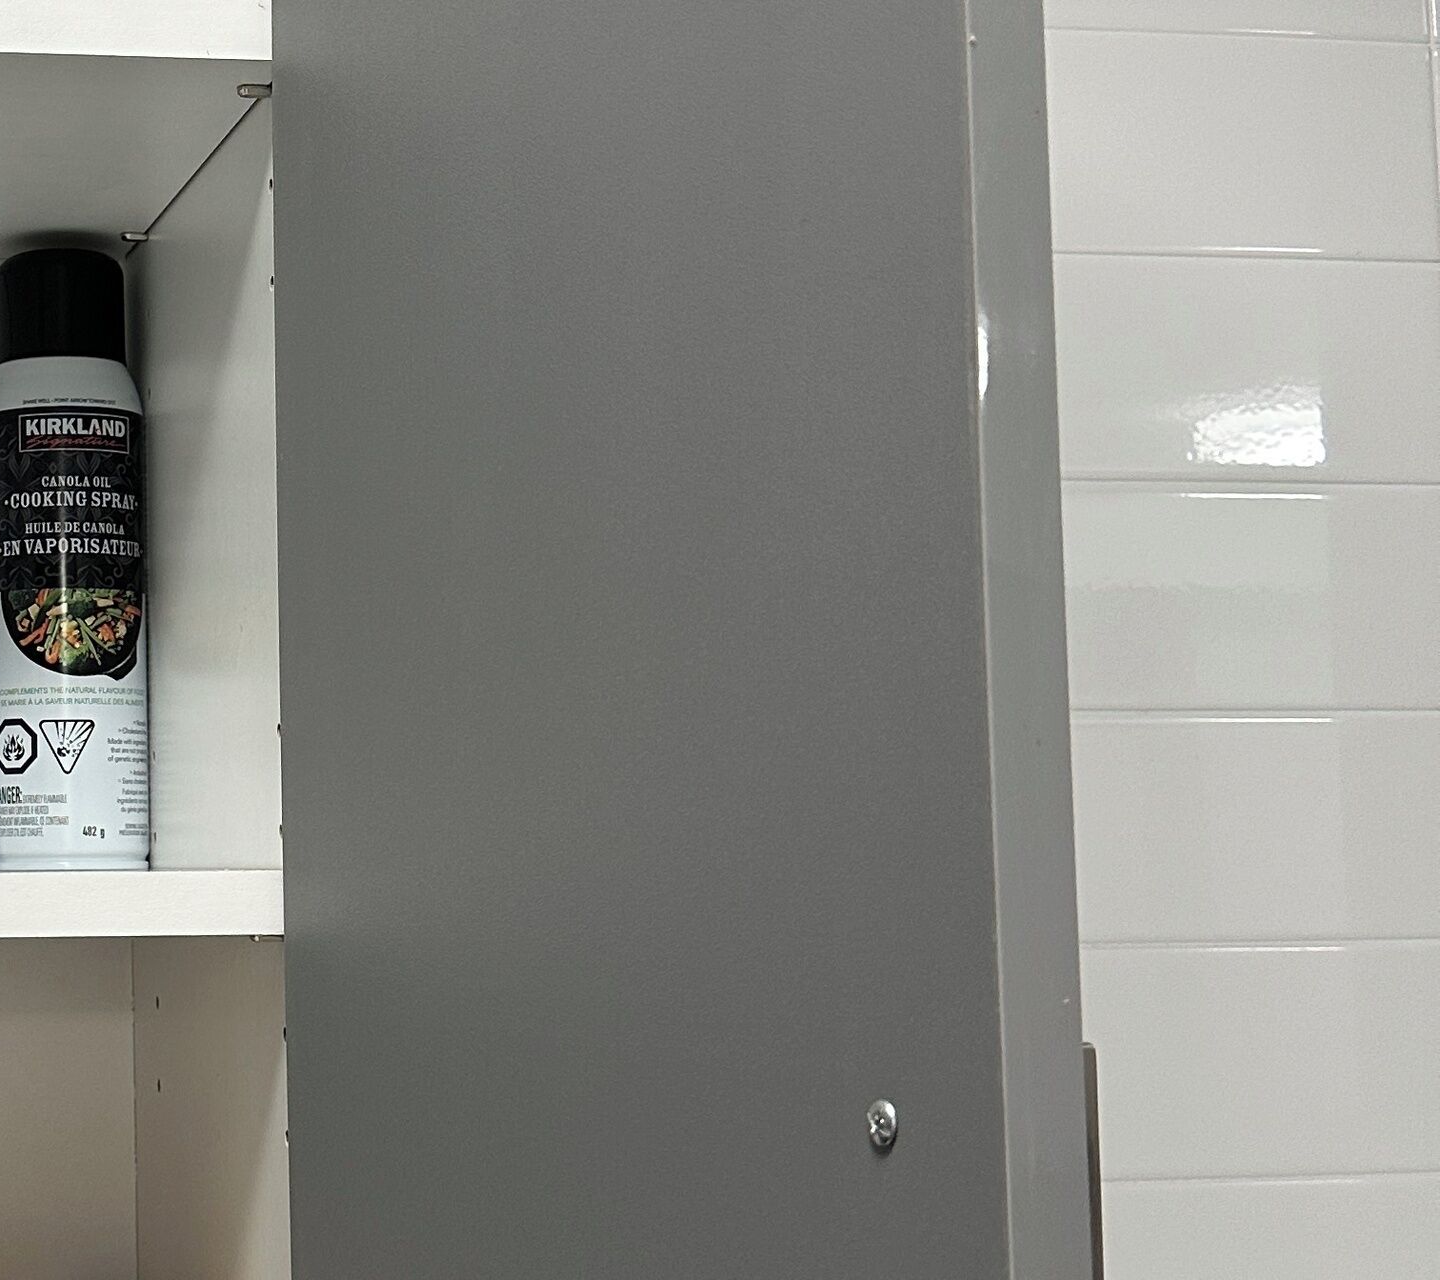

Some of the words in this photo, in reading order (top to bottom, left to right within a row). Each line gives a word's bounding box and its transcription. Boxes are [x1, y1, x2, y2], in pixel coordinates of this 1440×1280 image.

[25, 417, 126, 438] KIRKLAND
[26, 435, 126, 449] Signature
[41, 475, 90, 488] CANOLA
[93, 476, 111, 488] OIL
[10, 491, 87, 509] COOKING
[91, 491, 135, 511] SPRAY
[25, 521, 61, 534] HUILE
[64, 521, 80, 533] DE
[82, 522, 125, 535] CANOLA
[2, 540, 21, 557] EN
[24, 537, 141, 558] VAPORISATEUR
[65, 686, 97, 694] NATURAL
[83, 826, 97, 837] 482
[100, 828, 105, 838] g
